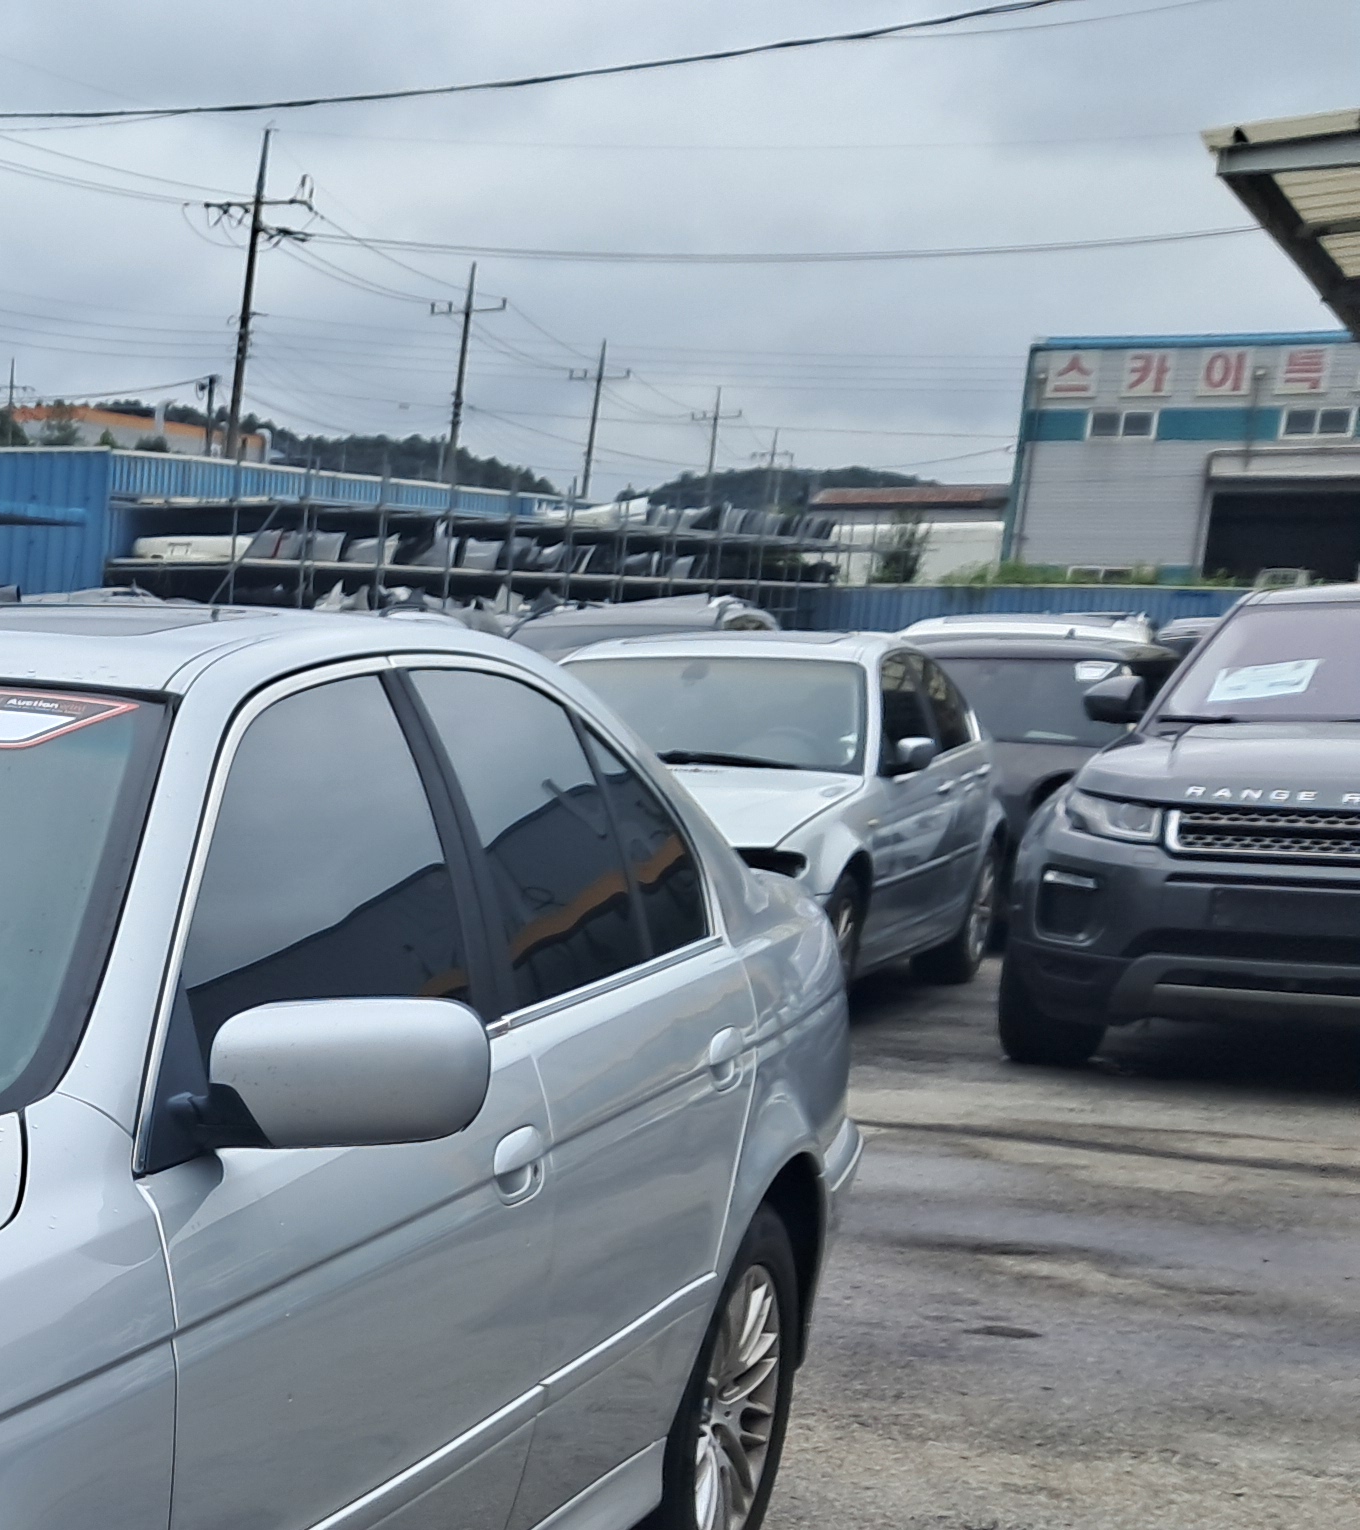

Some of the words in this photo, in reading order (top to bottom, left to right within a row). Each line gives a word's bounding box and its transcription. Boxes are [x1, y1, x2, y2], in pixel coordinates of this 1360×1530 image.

[1052, 349, 1324, 393] 스카이특
[6, 697, 59, 709] Auction
[1185, 786, 1319, 802] RANGE
